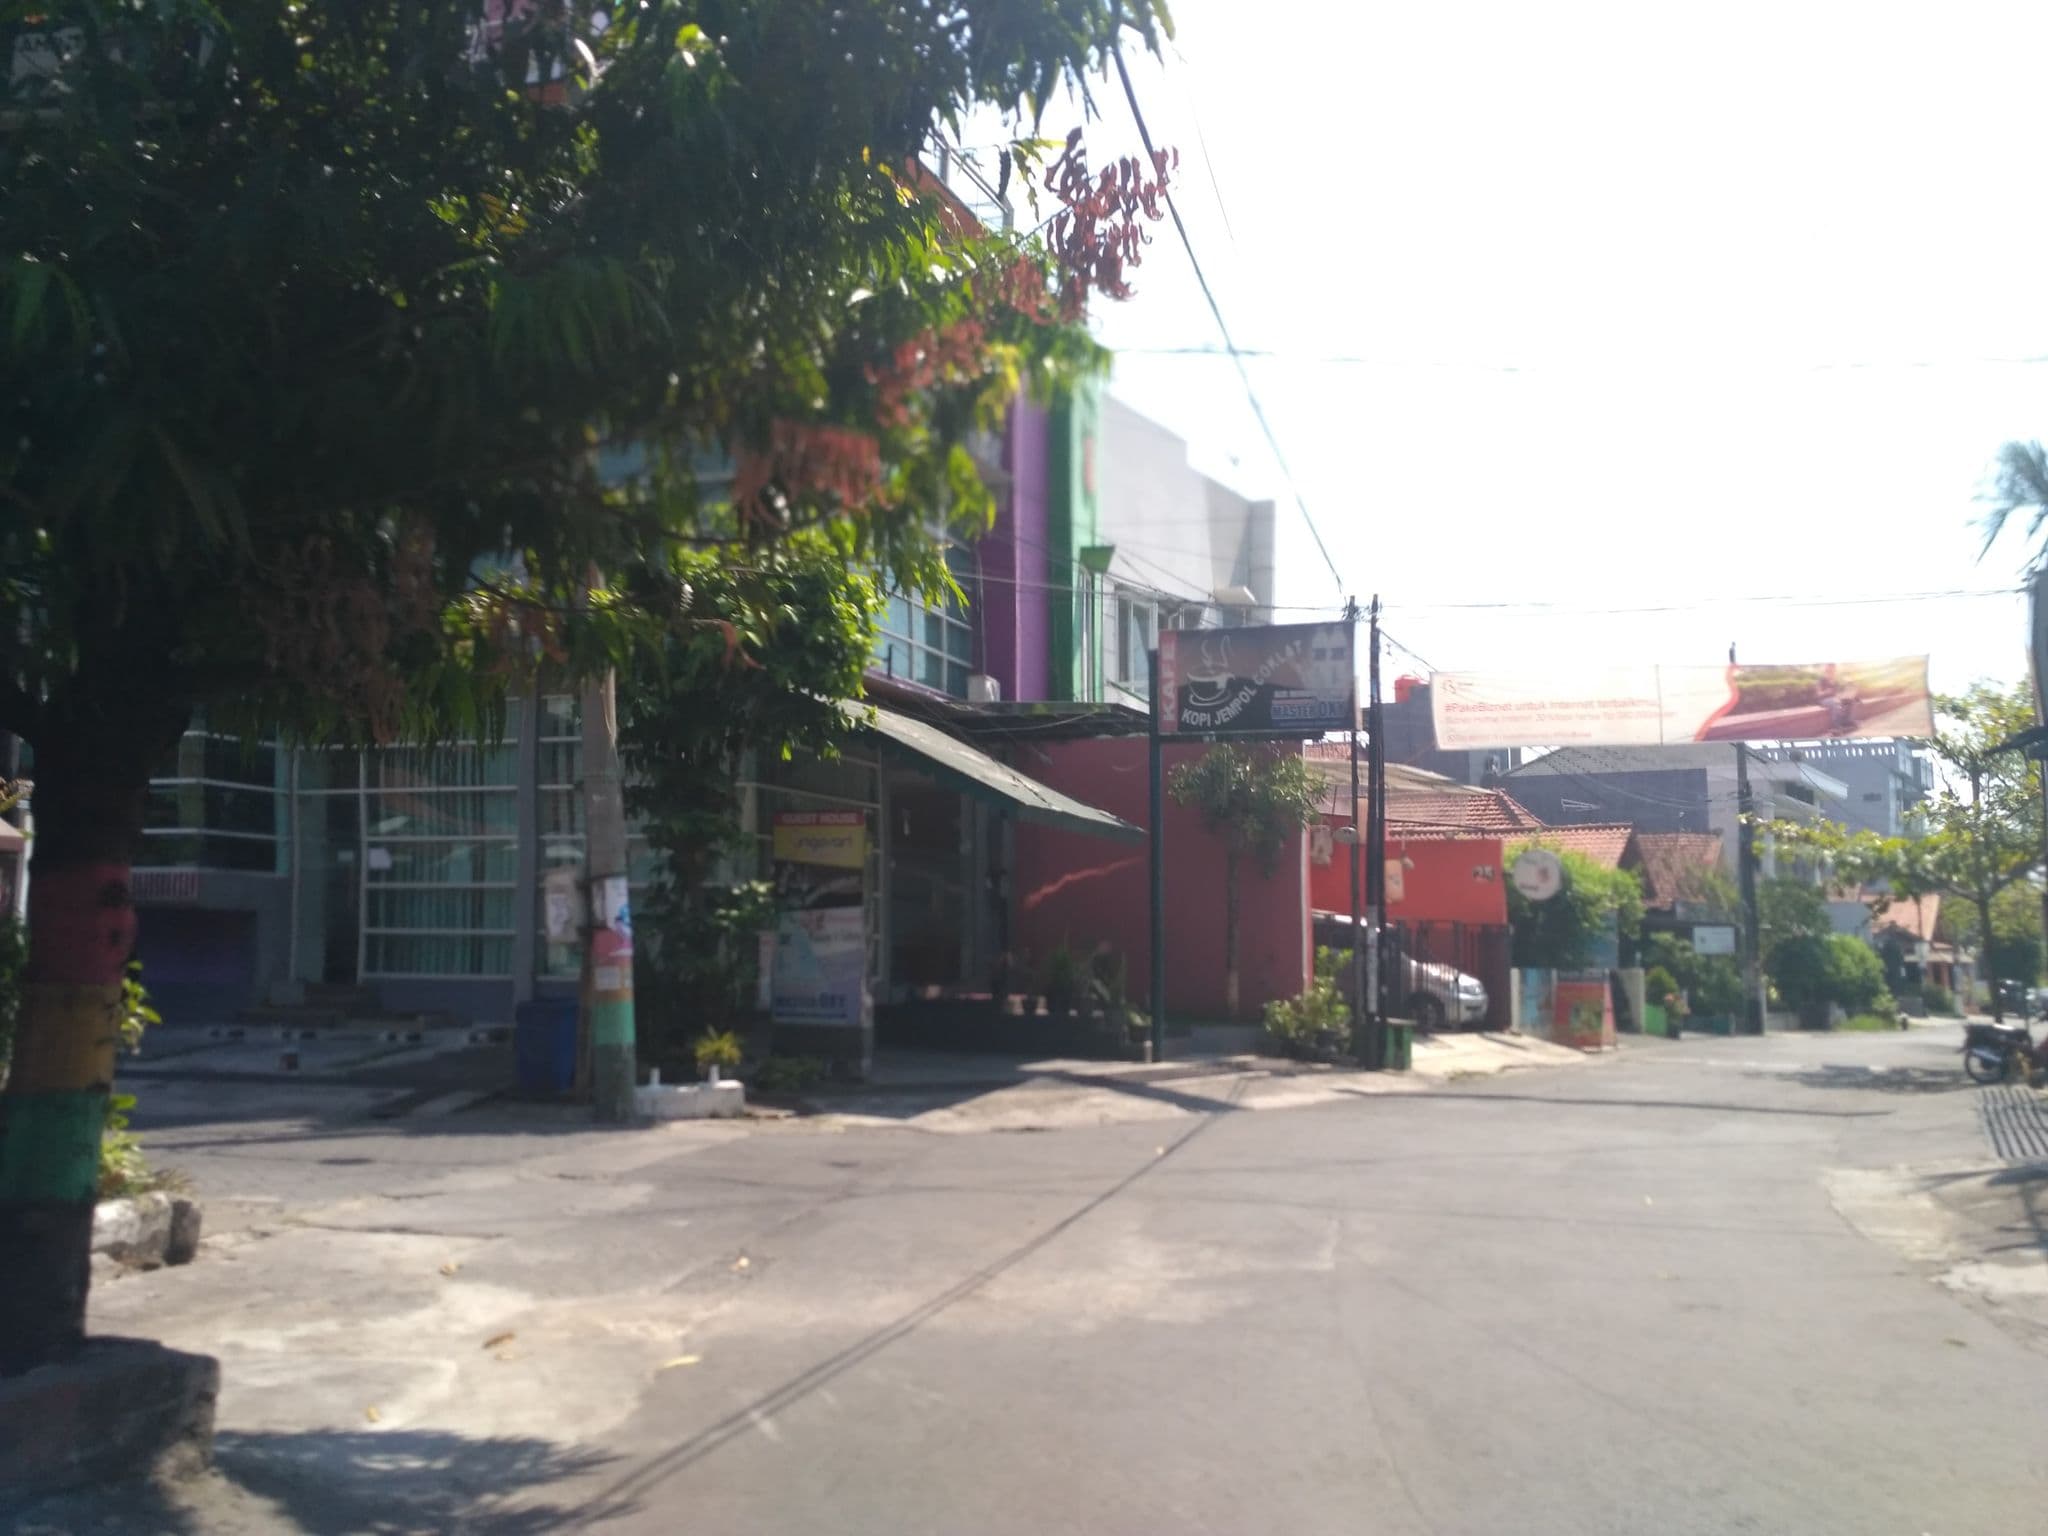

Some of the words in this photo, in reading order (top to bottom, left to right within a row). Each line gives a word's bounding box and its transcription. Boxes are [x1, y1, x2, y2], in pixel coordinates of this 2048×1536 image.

[1163, 640, 1176, 721] KAFE
[1181, 708, 1212, 727] KOPI
[1214, 685, 1257, 726] JEMPOL
[1253, 640, 1303, 686] COKLAT
